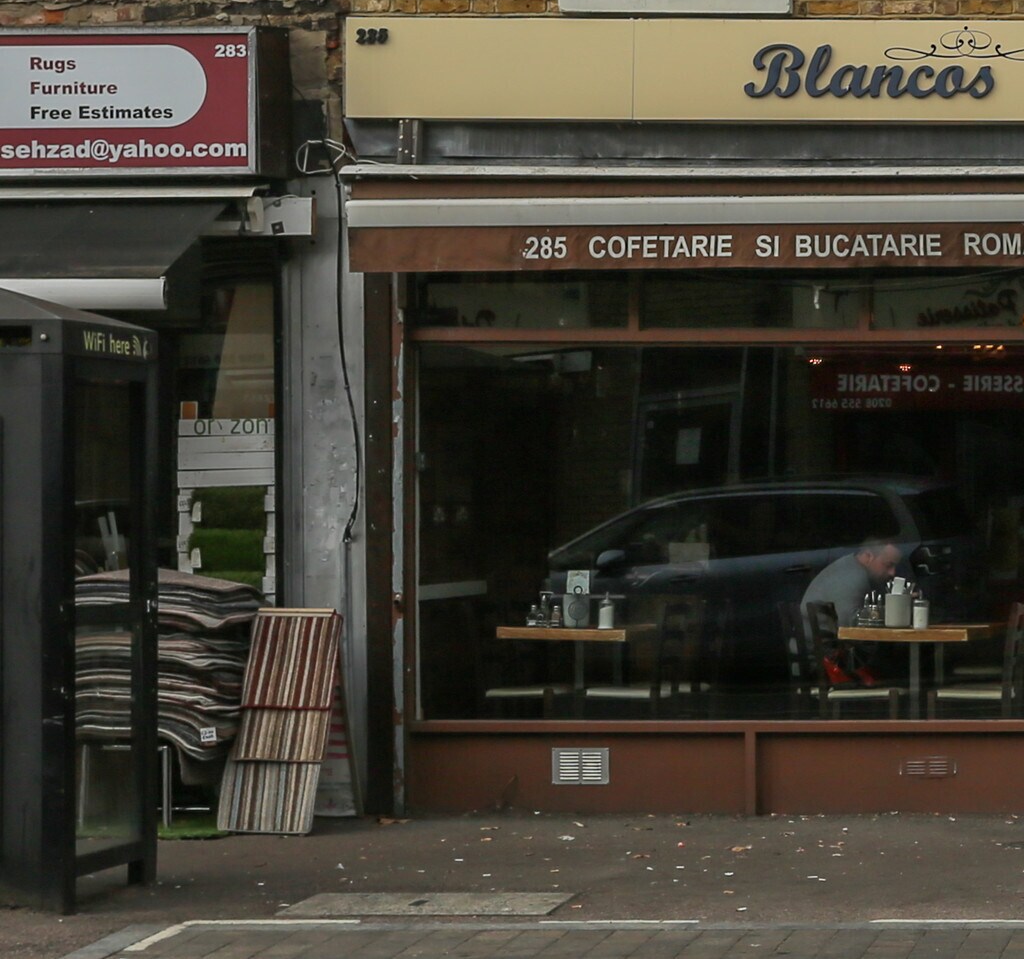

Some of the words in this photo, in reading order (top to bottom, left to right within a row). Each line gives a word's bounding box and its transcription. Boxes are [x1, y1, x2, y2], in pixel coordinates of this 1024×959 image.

[214, 44, 247, 58] 283
[29, 56, 77, 73] Rugs
[744, 43, 995, 99] Blancos
[29, 81, 118, 95] Furniture
[29, 106, 72, 120] Free
[78, 105, 174, 120] Estimates
[0, 139, 248, 162] sehzad@yahoo.com
[524, 235, 567, 260] 285
[588, 234, 733, 260] COFETARIE
[755, 234, 780, 259] SI
[795, 233, 942, 259] BUCATARIE
[83, 330, 106, 352] WiFi
[109, 333, 130, 355] here
